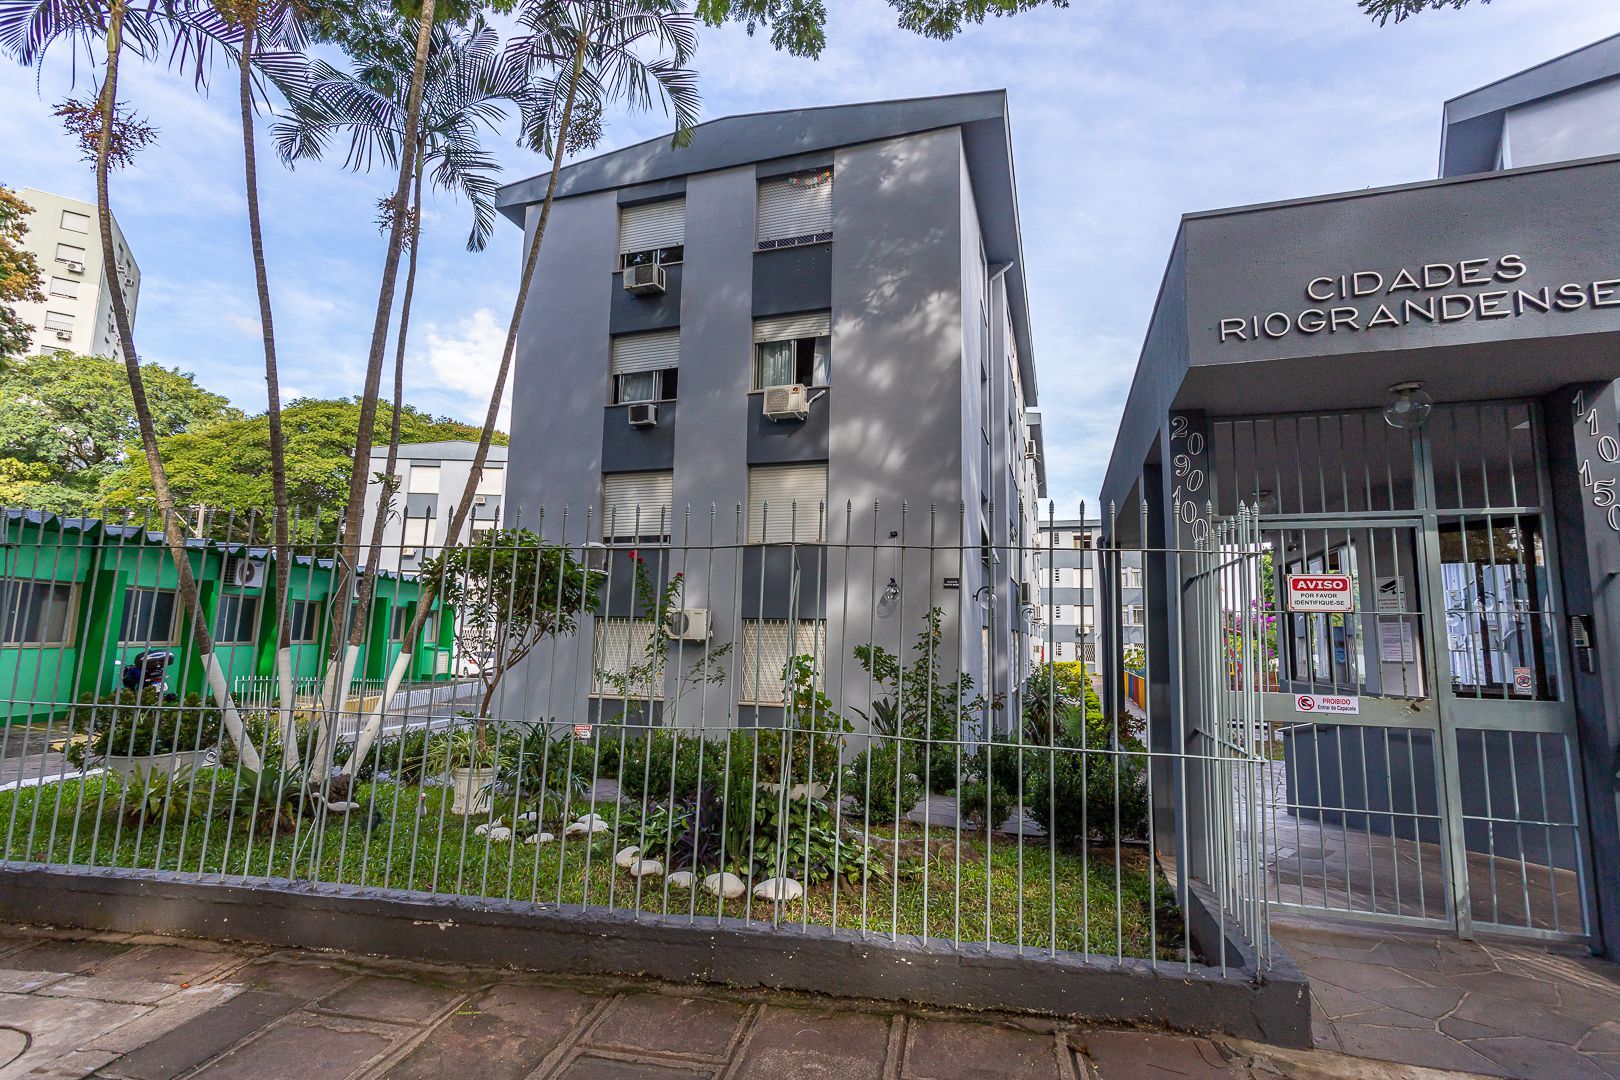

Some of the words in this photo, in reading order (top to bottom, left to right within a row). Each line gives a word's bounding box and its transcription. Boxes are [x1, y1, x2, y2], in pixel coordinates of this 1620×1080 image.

[1307, 254, 1526, 301] CIDADES
[1220, 279, 1620, 341] RIOGRANDENSE
[1297, 580, 1343, 589] AVISO
